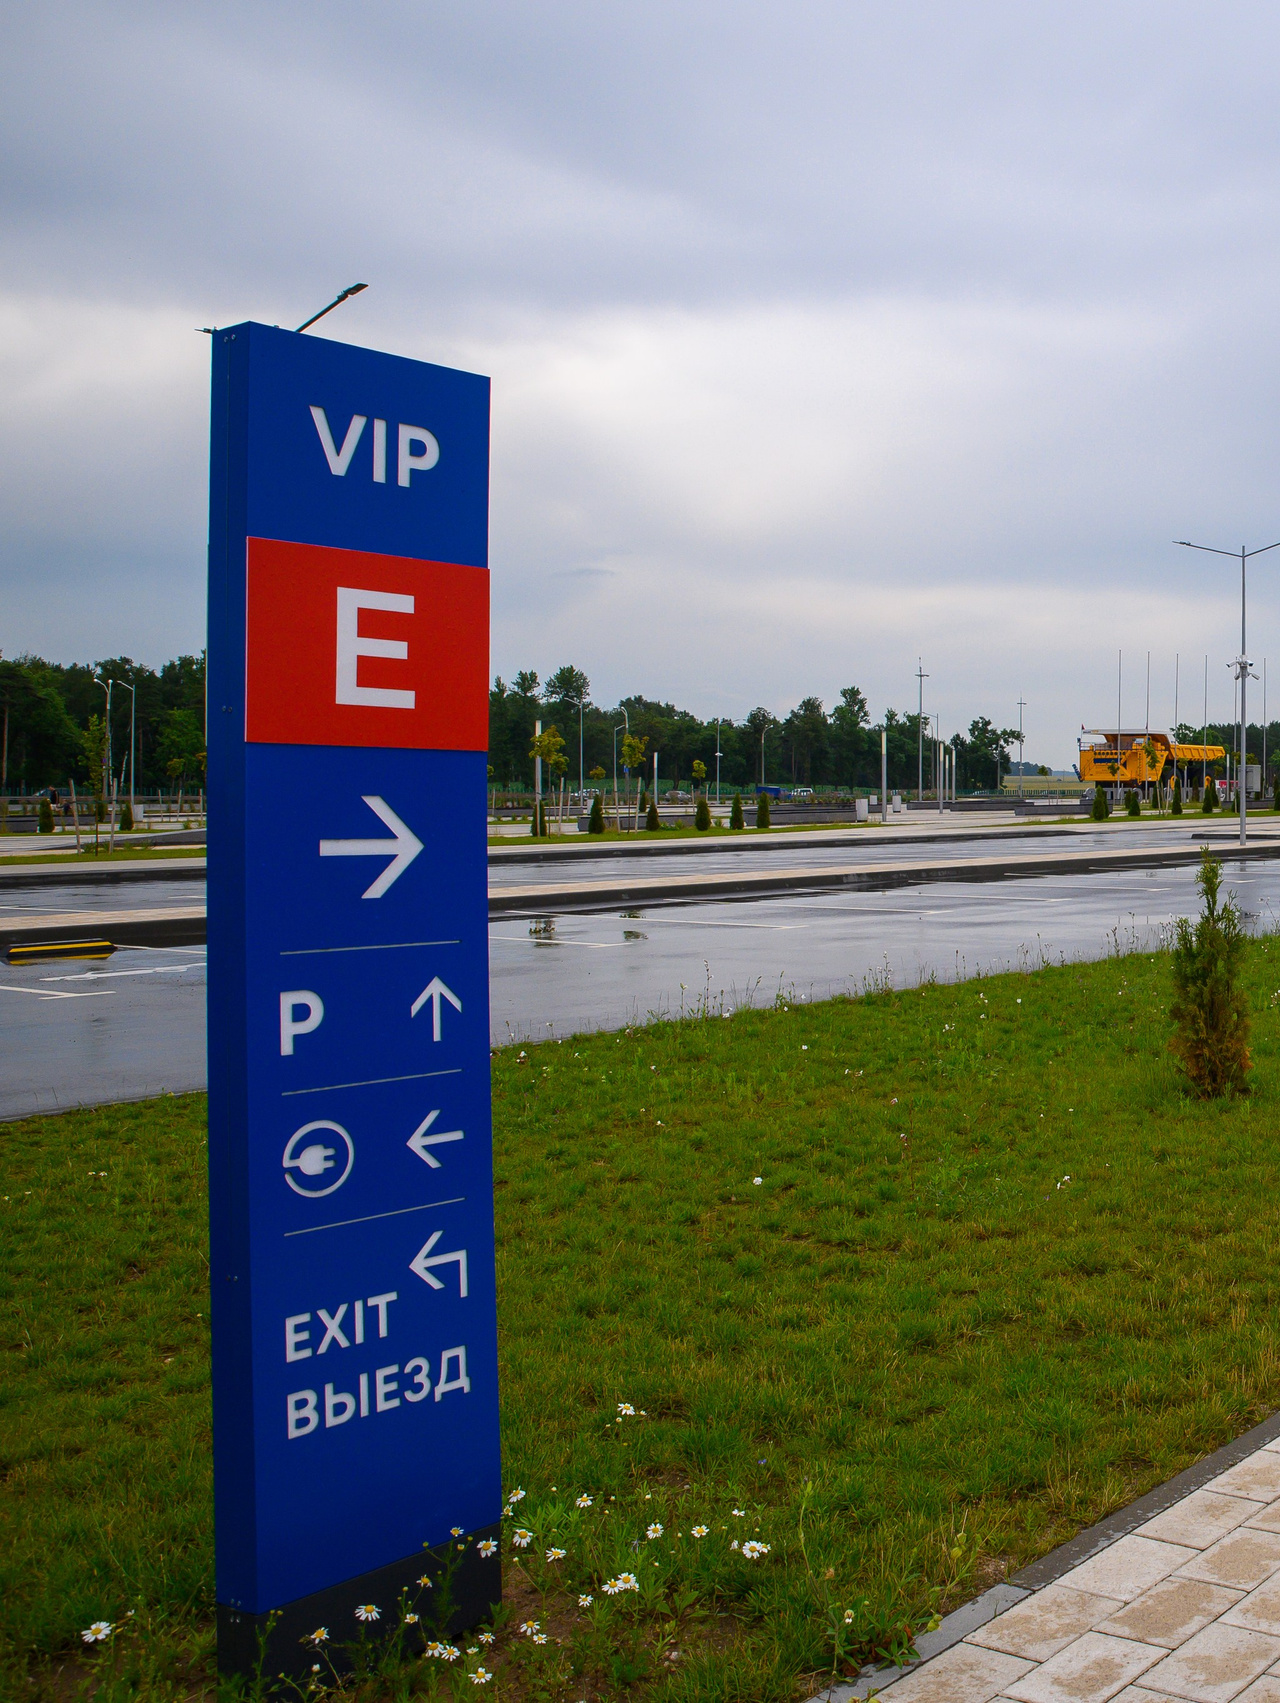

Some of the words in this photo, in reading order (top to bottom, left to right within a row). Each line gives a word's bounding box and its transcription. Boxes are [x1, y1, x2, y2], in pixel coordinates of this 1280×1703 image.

[309, 405, 440, 488] VIP
[335, 586, 416, 709] E
[280, 989, 324, 1056] P
[285, 1292, 398, 1363] EXIT
[286, 1345, 471, 1440] ВЫЕЗД
